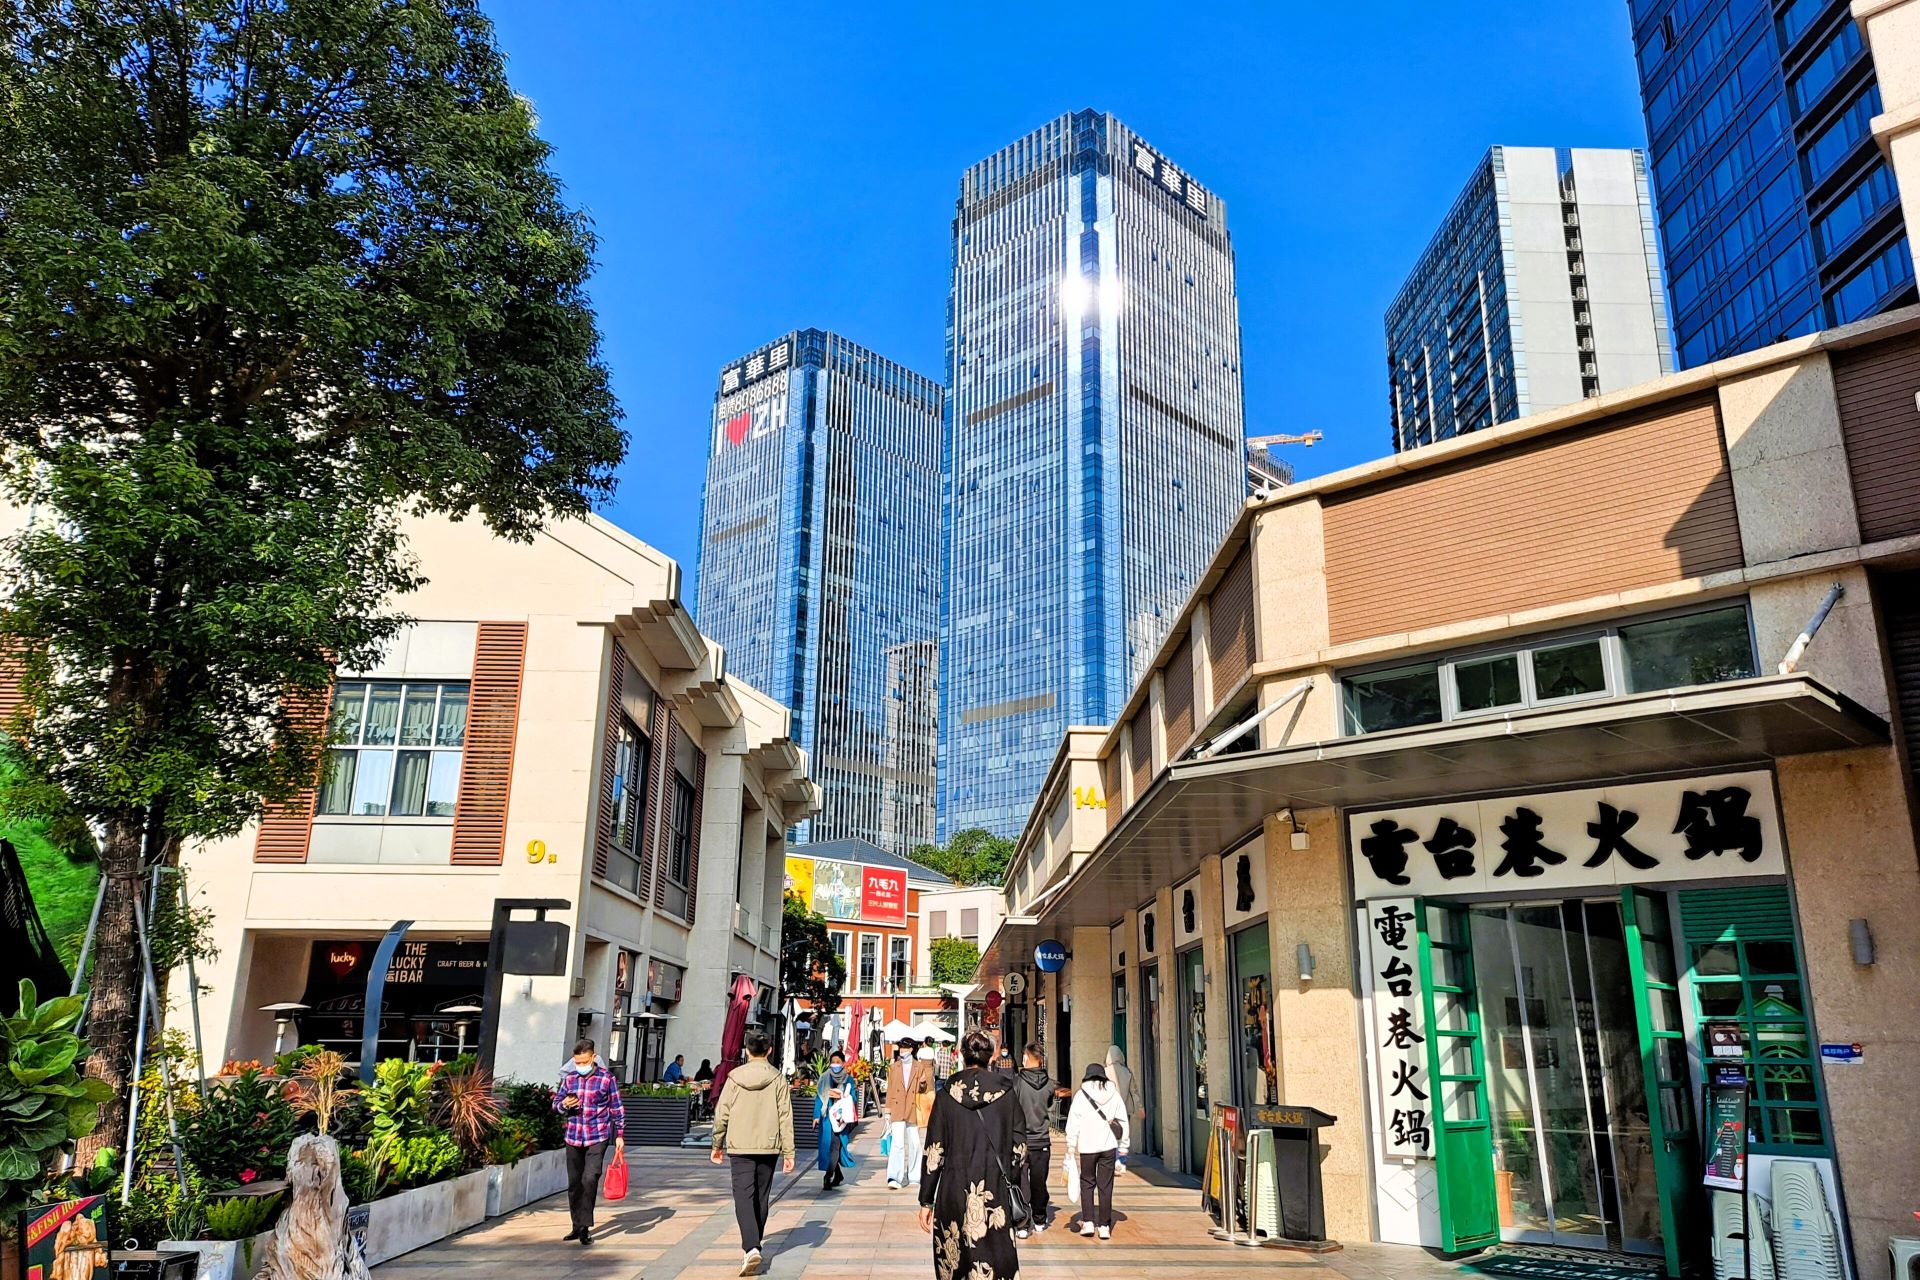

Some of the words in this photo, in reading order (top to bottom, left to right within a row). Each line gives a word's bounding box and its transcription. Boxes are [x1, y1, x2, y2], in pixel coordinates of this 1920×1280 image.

[1134, 144, 1207, 216] 富華里
[723, 342, 789, 393] 富華里
[1361, 786, 1763, 885] 電台巷火鍋
[868, 876, 899, 891] 九毛九
[330, 951, 356, 966] lucky
[404, 943, 428, 956] THE
[389, 956, 426, 969] LUCKY
[437, 960, 457, 968] CRAFT
[458, 960, 474, 968] BEER
[1373, 905, 1430, 1152] 電台巷火鍋
[37, 1210, 61, 1234] FISH
